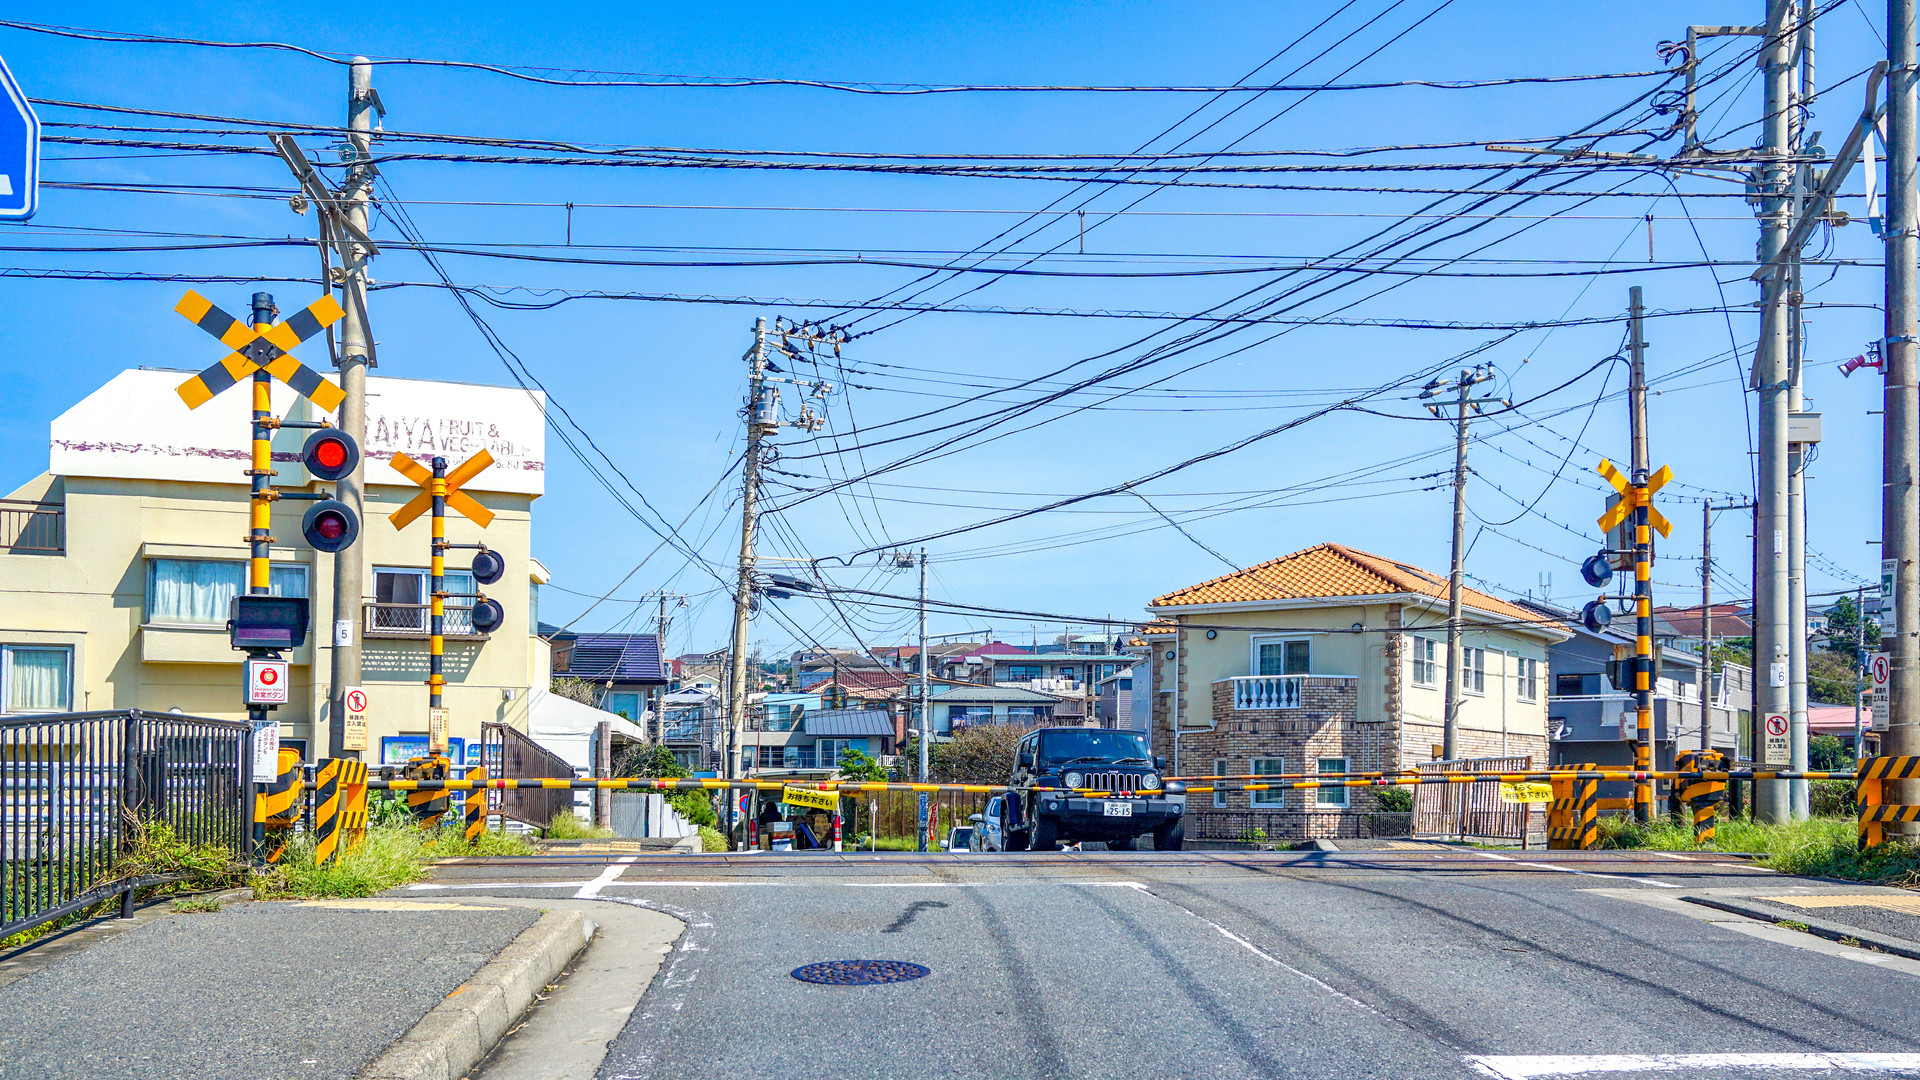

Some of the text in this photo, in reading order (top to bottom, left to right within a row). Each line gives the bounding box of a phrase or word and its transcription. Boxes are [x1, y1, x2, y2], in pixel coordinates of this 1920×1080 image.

[439, 418, 500, 438] FRUIT &
[341, 629, 348, 639] 5
[1778, 671, 1785, 681] 6
[254, 691, 284, 699] 非常ボタン
[787, 793, 832, 806] お待ち下さい
[1110, 807, 1131, 816] 25-15
